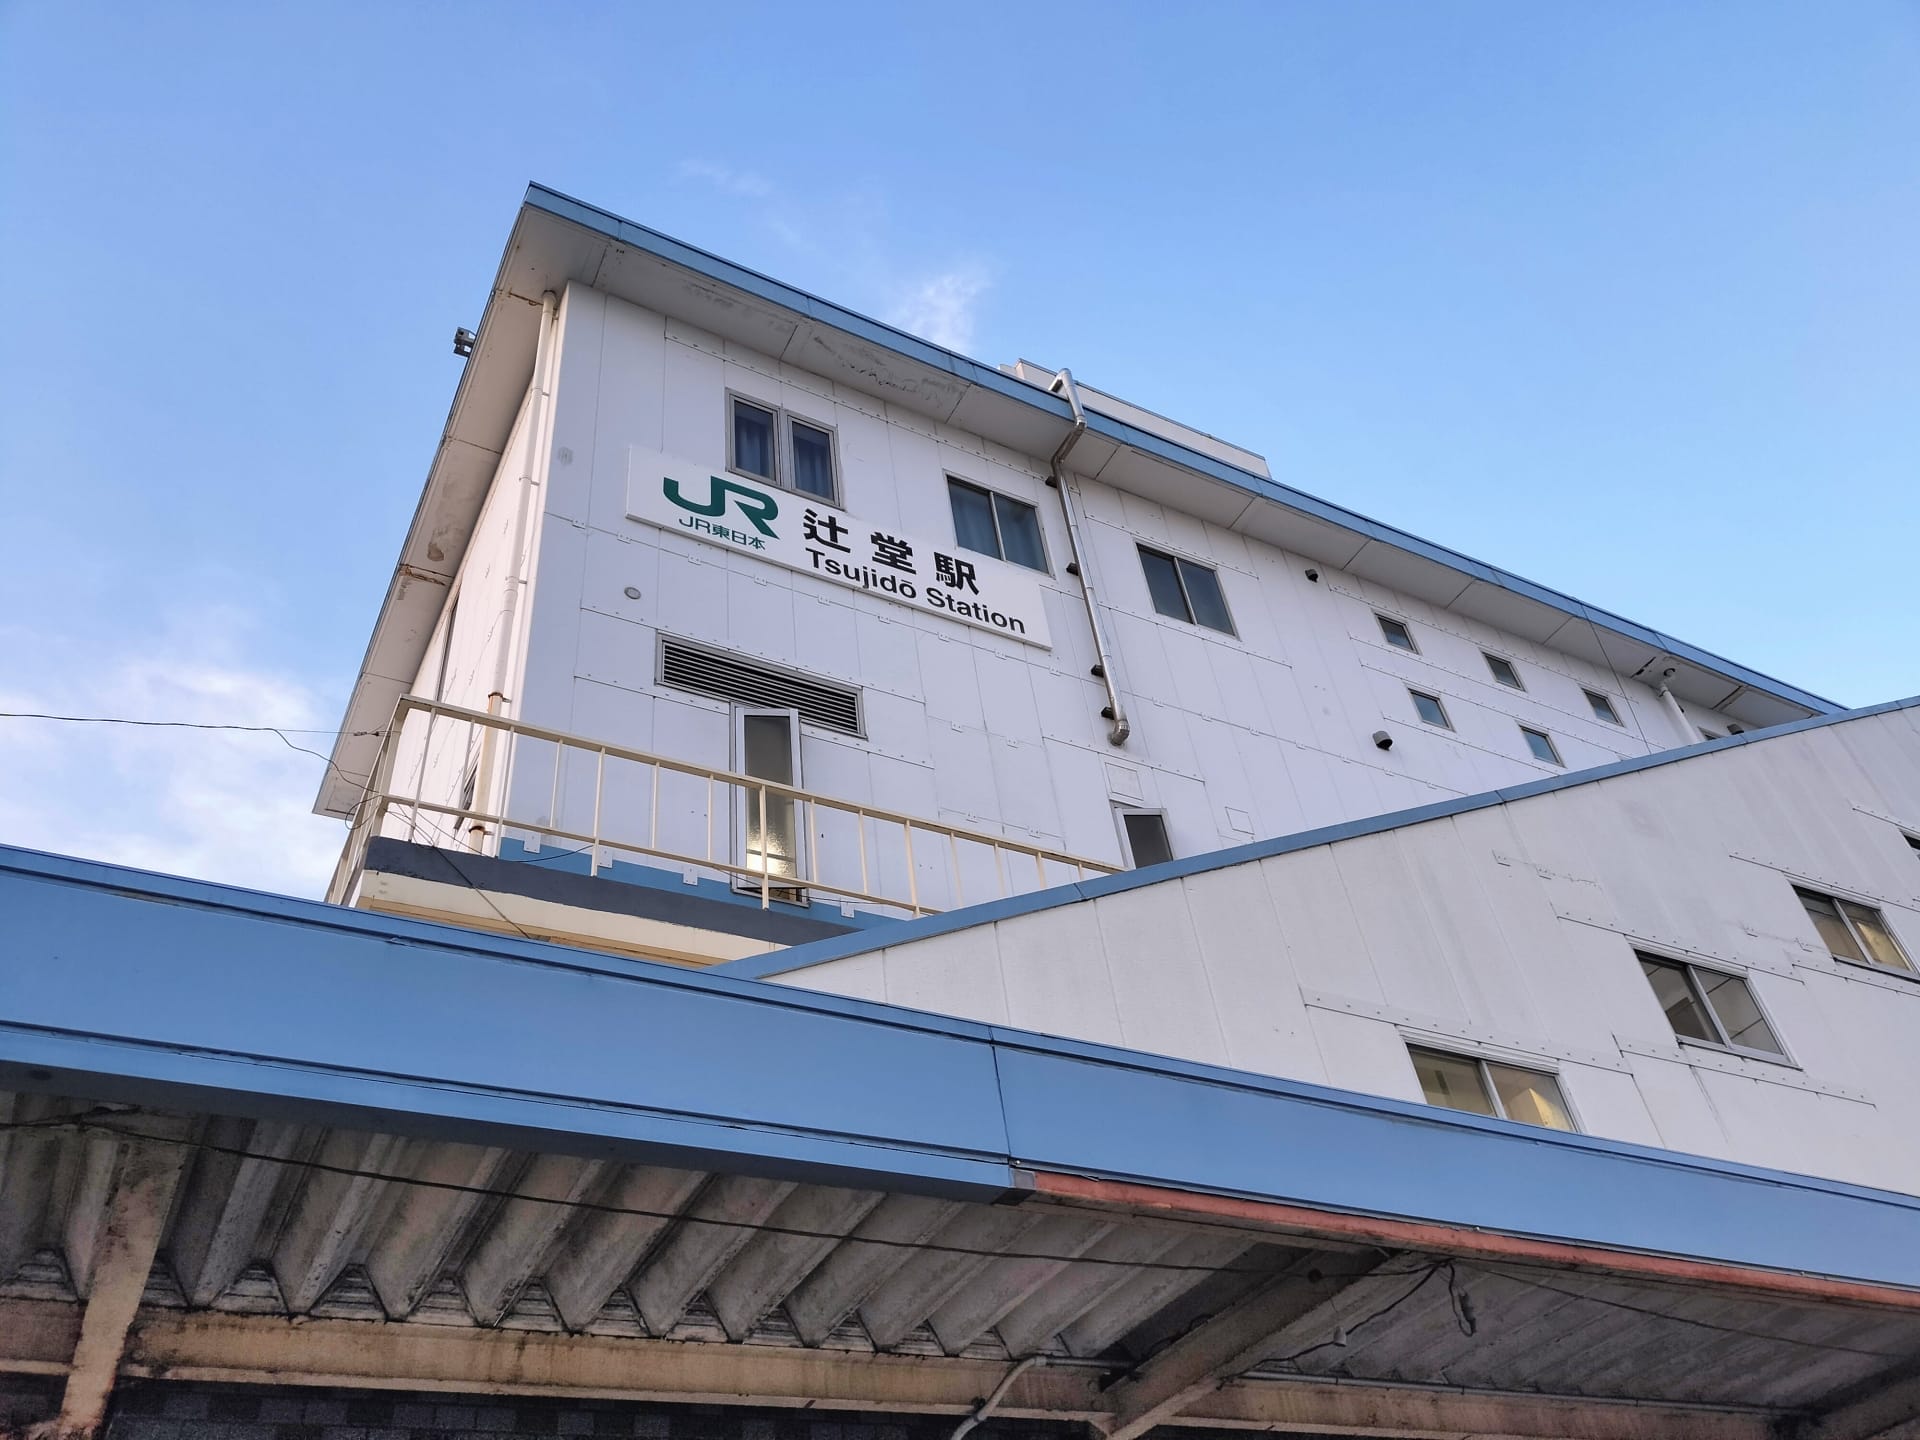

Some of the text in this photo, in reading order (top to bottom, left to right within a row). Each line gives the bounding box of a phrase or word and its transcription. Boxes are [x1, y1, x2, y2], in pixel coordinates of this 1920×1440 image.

[663, 476, 779, 539] JR
[679, 516, 765, 550] JR東日本
[803, 508, 979, 594] 辻堂駅
[806, 548, 1025, 634] Tsujidō Station
